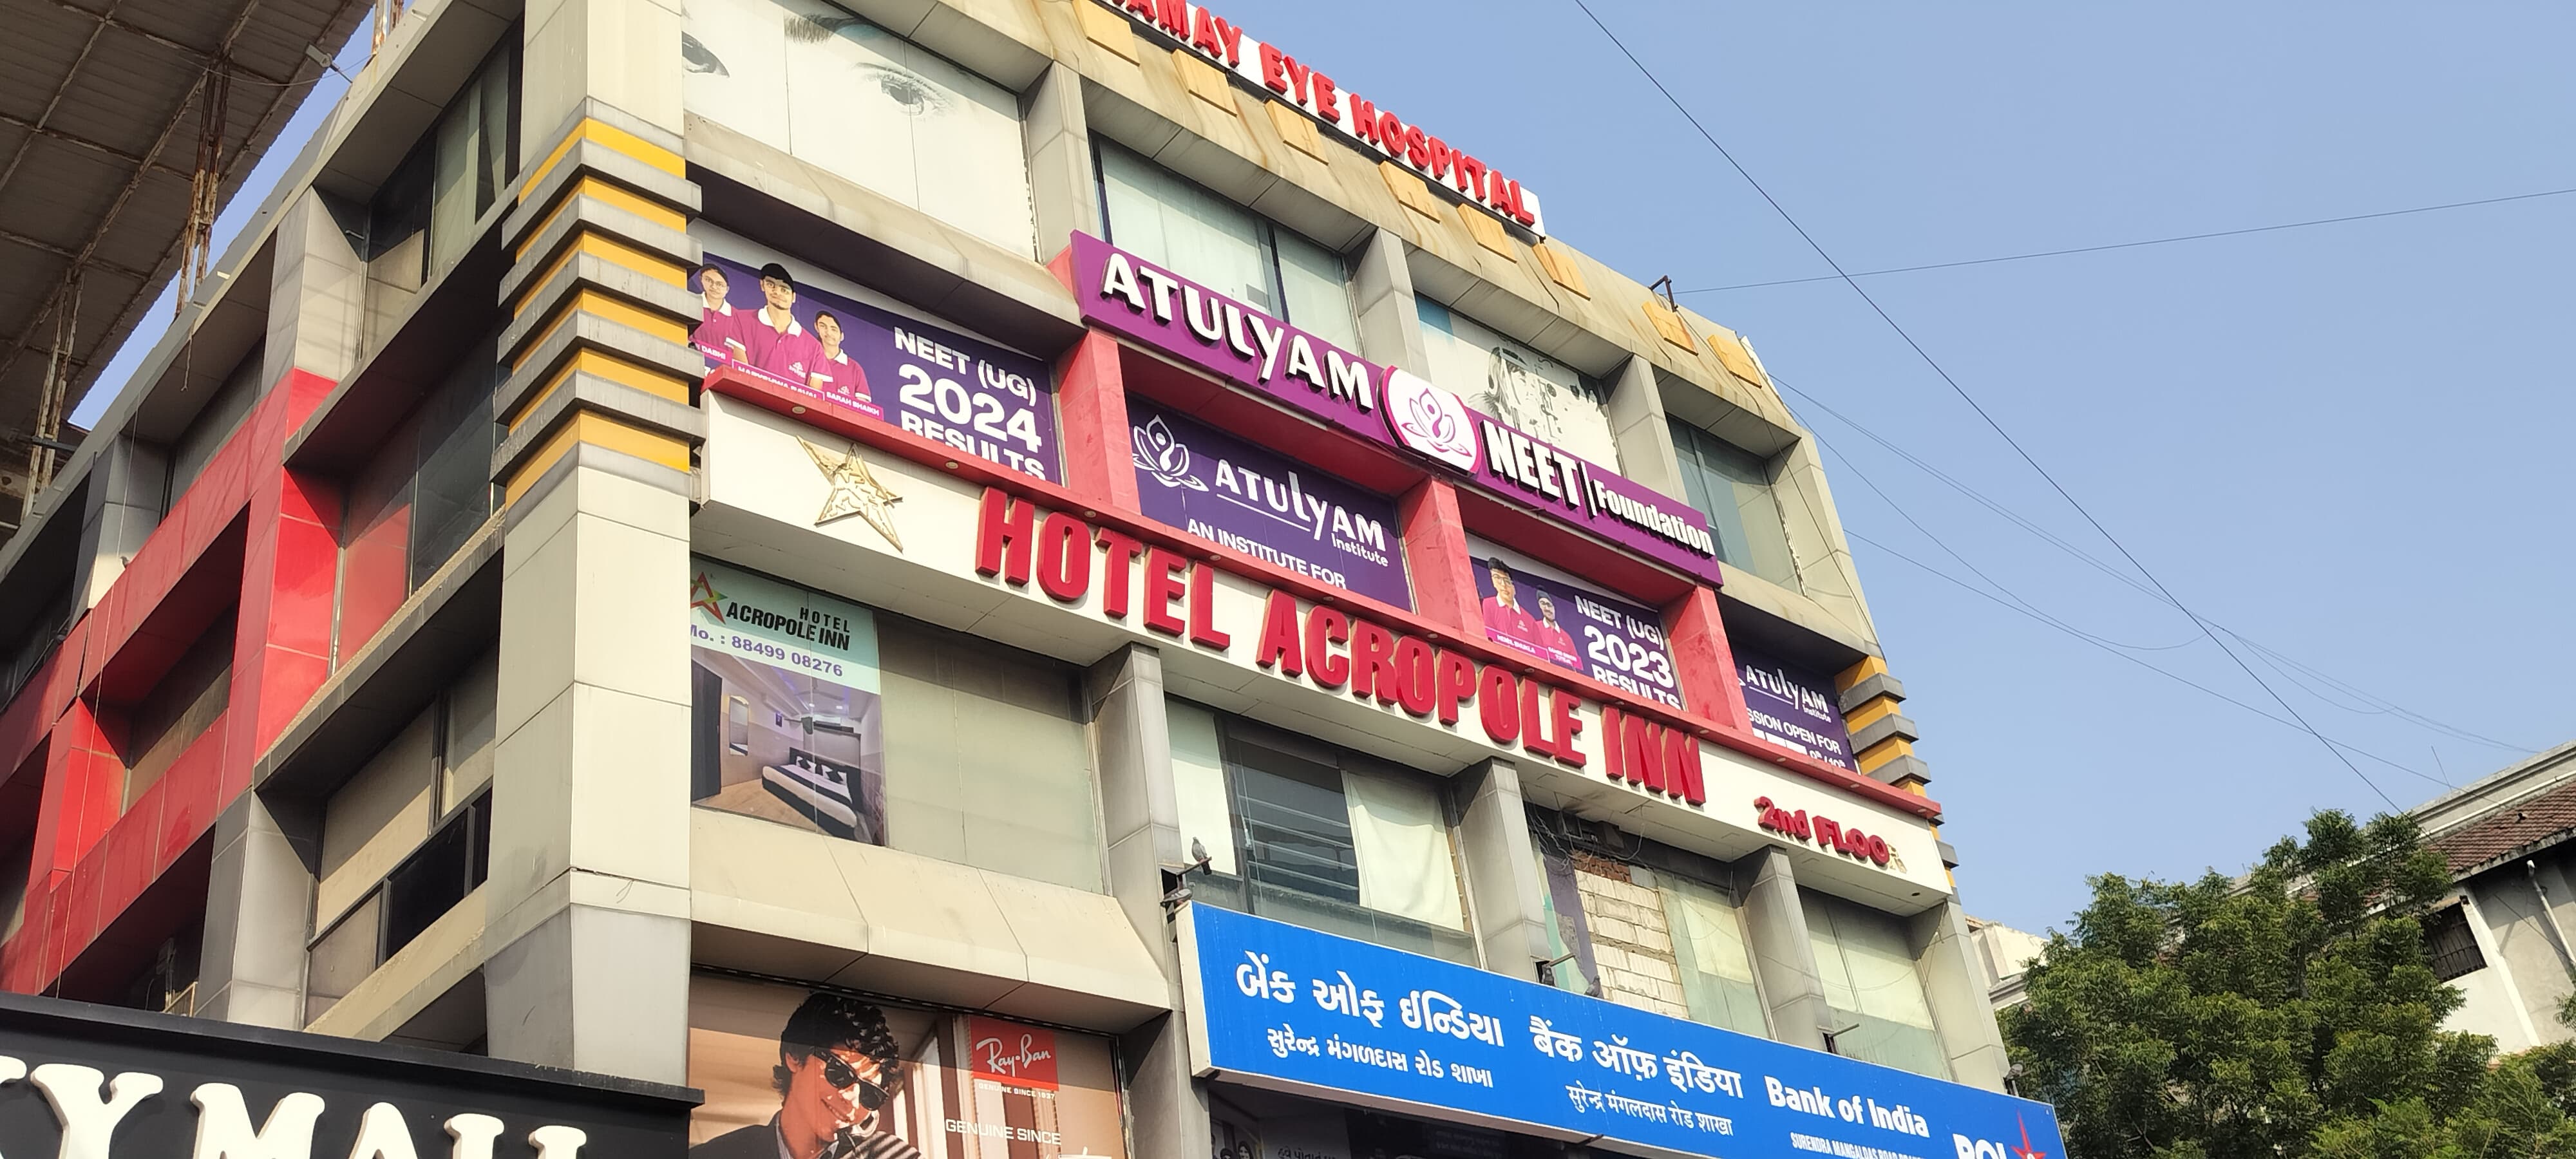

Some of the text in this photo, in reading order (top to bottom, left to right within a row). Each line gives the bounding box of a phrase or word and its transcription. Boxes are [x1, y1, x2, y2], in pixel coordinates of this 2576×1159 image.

[1259, 41, 1340, 124] EYE
[1350, 93, 1535, 227] HOSPITAL
[895, 326, 1037, 406] NEET (UG)
[899, 364, 1043, 453] 2024
[1480, 419, 1716, 558] NEET Foundation
[1188, 518, 1347, 590] AN INSTITUTE FOR
[1331, 533, 1389, 568] Institute
[726, 601, 850, 651] ACROPOLE INN
[800, 607, 850, 633] HOTEL
[975, 486, 1707, 806] HOTEL ACROPOLE INN
[1574, 594, 1665, 650] NEET (UG)
[732, 635, 786, 661] 88499
[791, 652, 844, 677] 08276
[1584, 625, 1674, 688] 2023
[1783, 722, 1817, 746] OPEN
[1816, 733, 1842, 756] FOR
[1754, 796, 1812, 841] 2nd
[1236, 950, 1505, 1048] બેંક ઓફ ઈન્ડિયા
[1267, 1023, 1494, 1088] સુરેન્દ્ર મંગળદાસ રોડ શાખા
[1529, 1015, 1584, 1062] बैंक
[1662, 1050, 1745, 1099] इंडिया
[978, 1082, 1012, 1093] GENUINE
[1605, 1089, 1668, 1124] मंगलदास
[1669, 1100, 1694, 1129] रोड
[1694, 1113, 1734, 1136] शाखा
[1764, 1075, 1930, 1138] Bank of India
[945, 1118, 1062, 1145] GENUINE SINCE
[1790, 1131, 1833, 1155] SURENDRA
